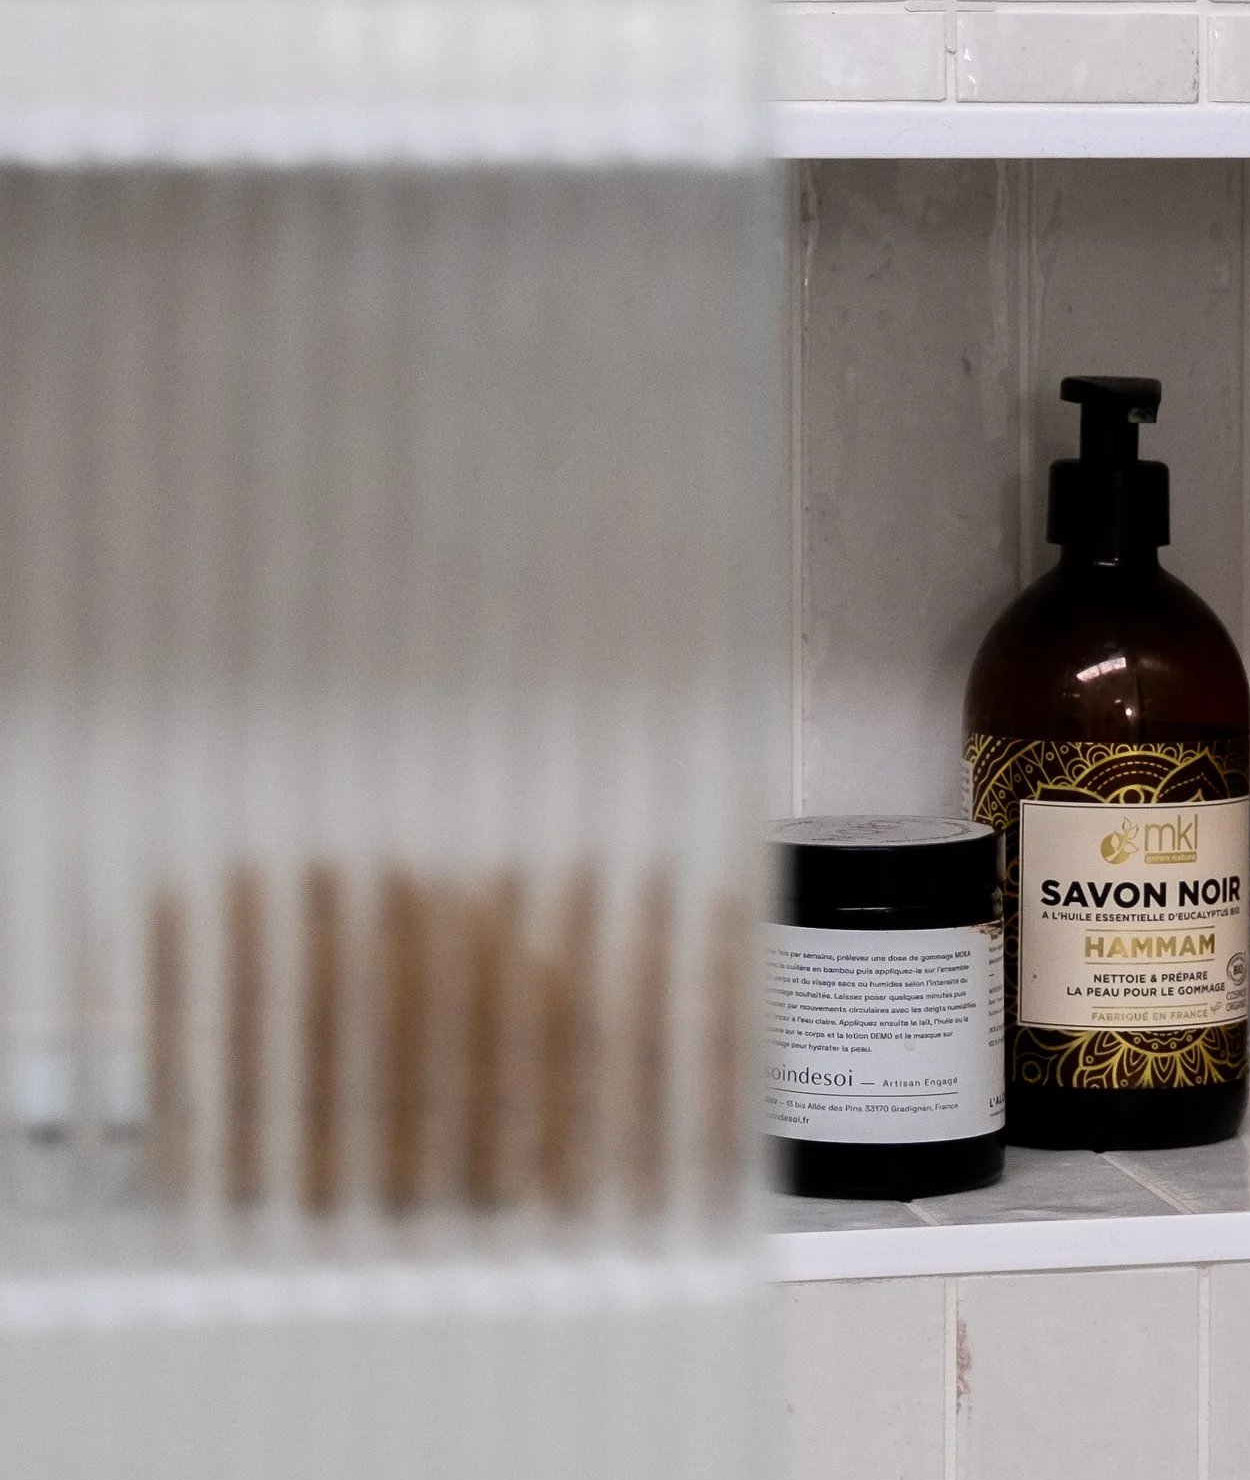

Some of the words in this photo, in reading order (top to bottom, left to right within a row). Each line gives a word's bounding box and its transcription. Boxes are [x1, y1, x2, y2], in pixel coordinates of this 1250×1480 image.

[1144, 813, 1198, 852] mkl
[1041, 879, 1167, 909] SAVON
[1178, 876, 1241, 908] NOIR
[1052, 912, 1092, 922] L'HUILE
[1096, 913, 1165, 923] ESSENTIELLE
[1168, 908, 1229, 922] D'EUCALYPTUS
[1084, 933, 1216, 959] HAMMAM
[823, 966, 854, 975] bambou
[856, 967, 873, 976] puis
[1093, 973, 1146, 984] NETTOIE
[1150, 973, 1157, 983] &
[1161, 970, 1208, 983] PRÉPARE
[1066, 986, 1082, 997] LA
[1086, 987, 1120, 998] PEAU
[1124, 986, 1157, 998] POUR
[1161, 986, 1174, 996] LE
[1178, 982, 1226, 997] GOMMAGE
[1091, 1008, 1148, 1022] FABRIQUÉ
[1152, 1010, 1167, 1021] EN
[1170, 1008, 1209, 1020] FRANCE
[766, 1064, 853, 1087] soindesoi
[883, 1079, 921, 1088] Artisan
[924, 1076, 958, 1088] Engagé
[828, 1104, 843, 1112] des
